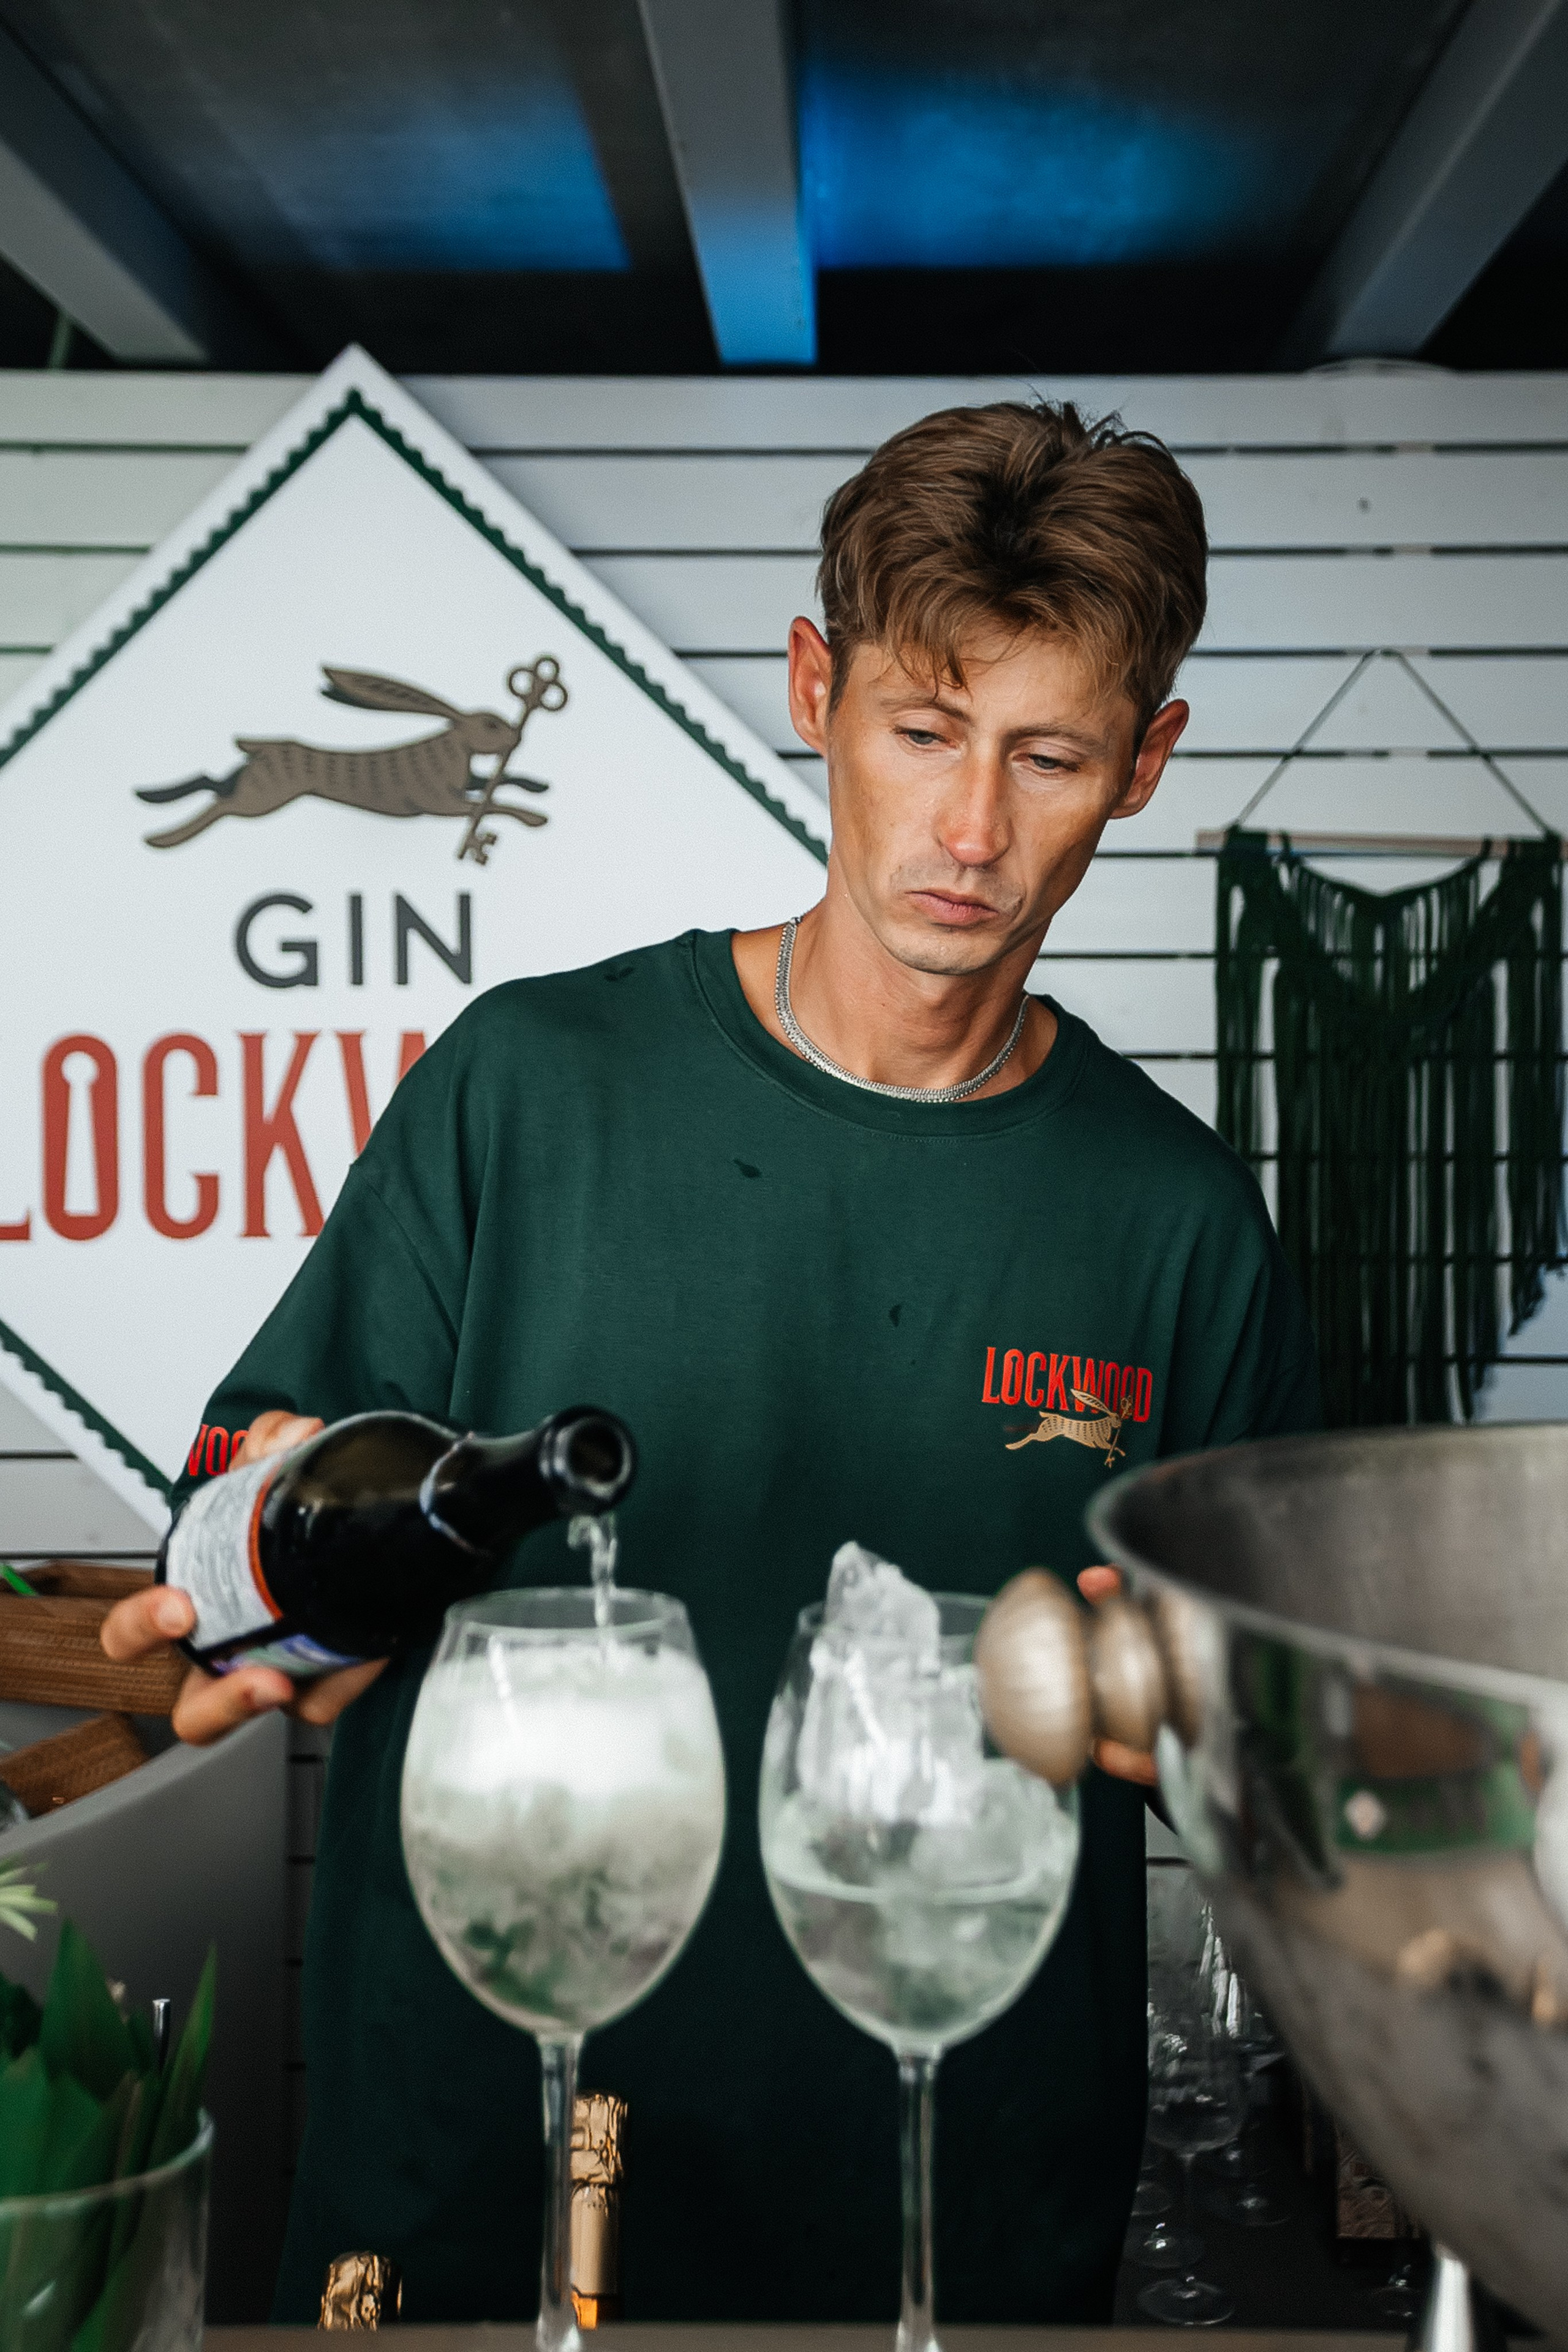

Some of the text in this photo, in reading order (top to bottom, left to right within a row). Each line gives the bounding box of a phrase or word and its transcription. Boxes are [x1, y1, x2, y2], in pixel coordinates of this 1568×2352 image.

[235, 892, 472, 989] GIN
[0, 1030, 430, 1242] OCK
[981, 1346, 1153, 1423] LOCKWOOD
